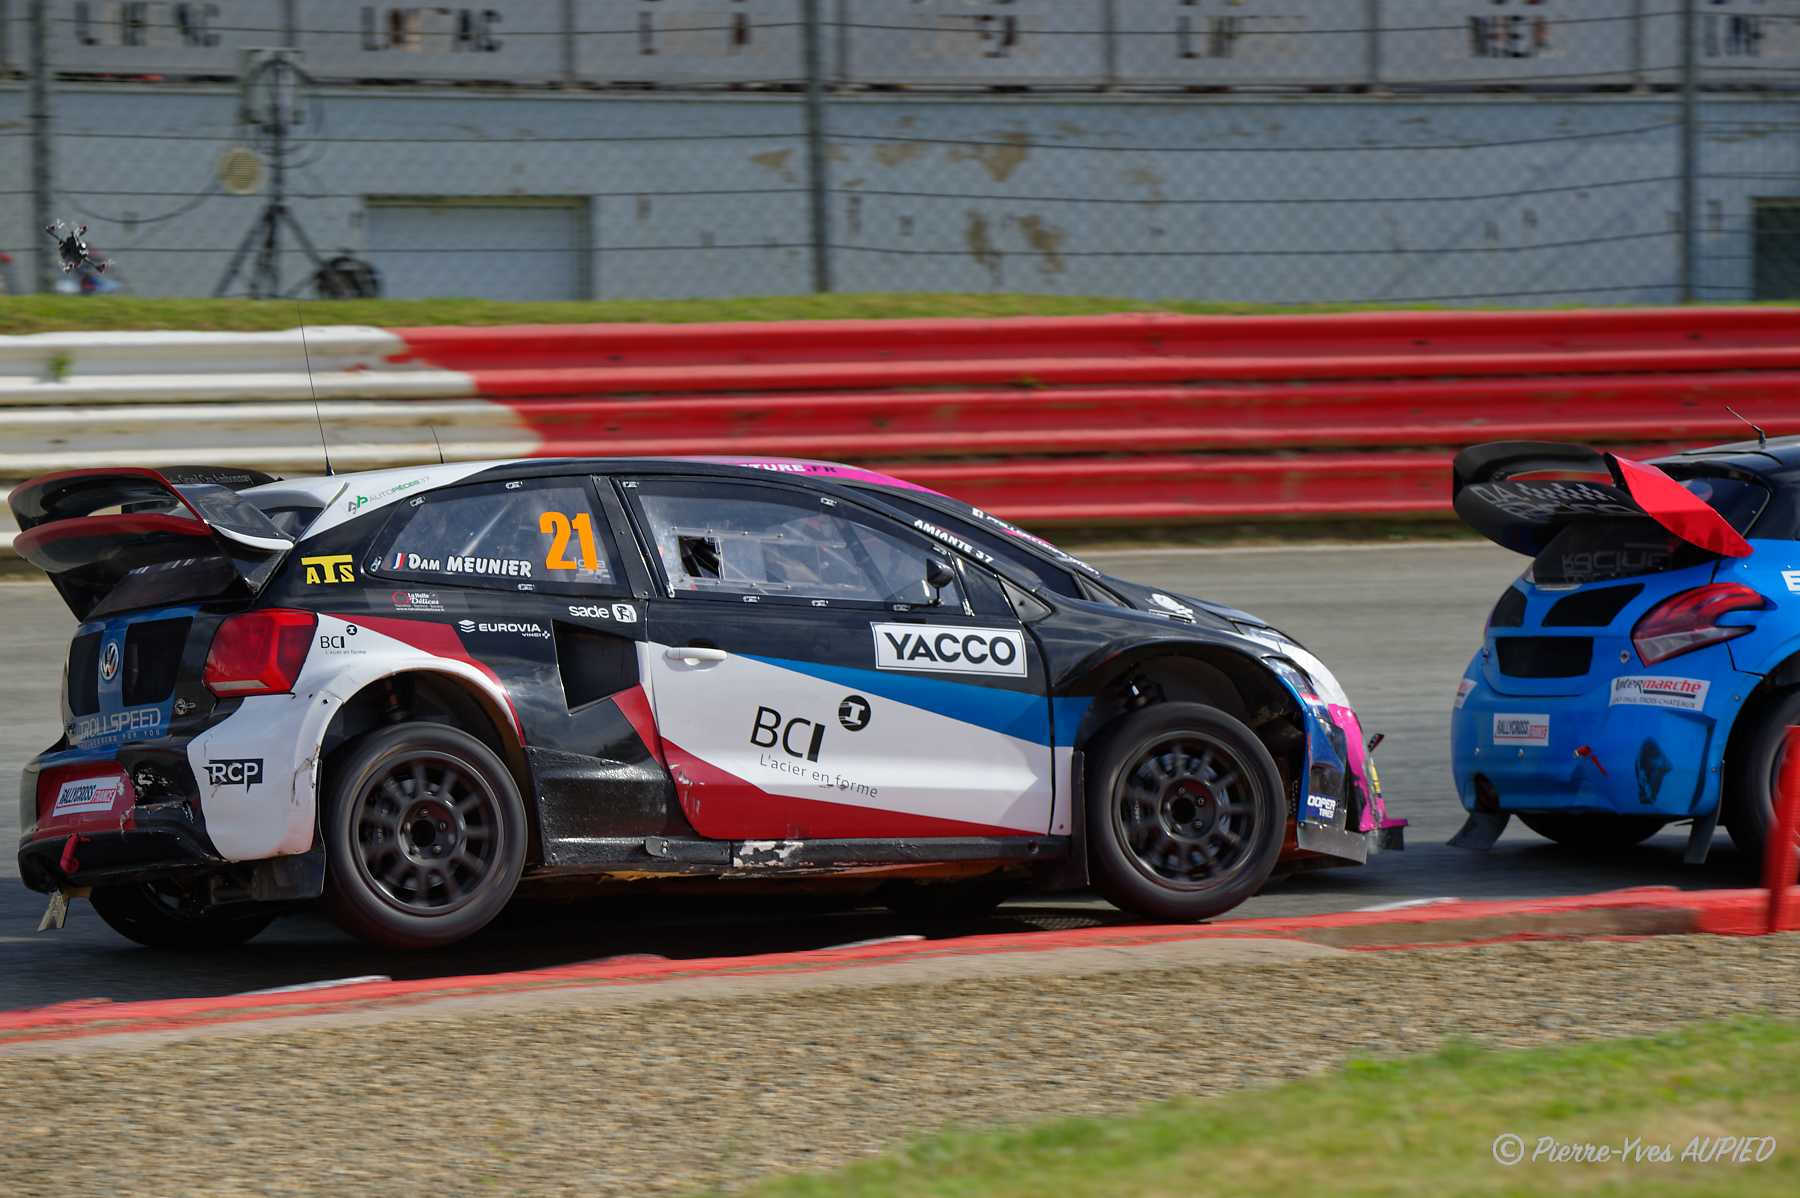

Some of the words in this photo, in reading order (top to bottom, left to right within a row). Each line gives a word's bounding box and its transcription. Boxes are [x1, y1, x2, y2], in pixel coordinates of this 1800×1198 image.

[538, 512, 599, 577] 21
[914, 519, 973, 557] AMIANTE
[975, 551, 994, 564] 37
[301, 554, 356, 585] ATS
[447, 556, 532, 578] MEUNIER
[568, 605, 609, 623] sade
[478, 623, 542, 633] EUROVIA
[320, 635, 346, 649] BCI
[883, 630, 1017, 666] YACCO
[749, 705, 826, 764] BCI
[211, 763, 259, 785] RCP
[759, 753, 808, 780] L'acier
[812, 769, 831, 785] en
[833, 773, 880, 799] forme
[60, 784, 97, 805] RALLYCROSS
